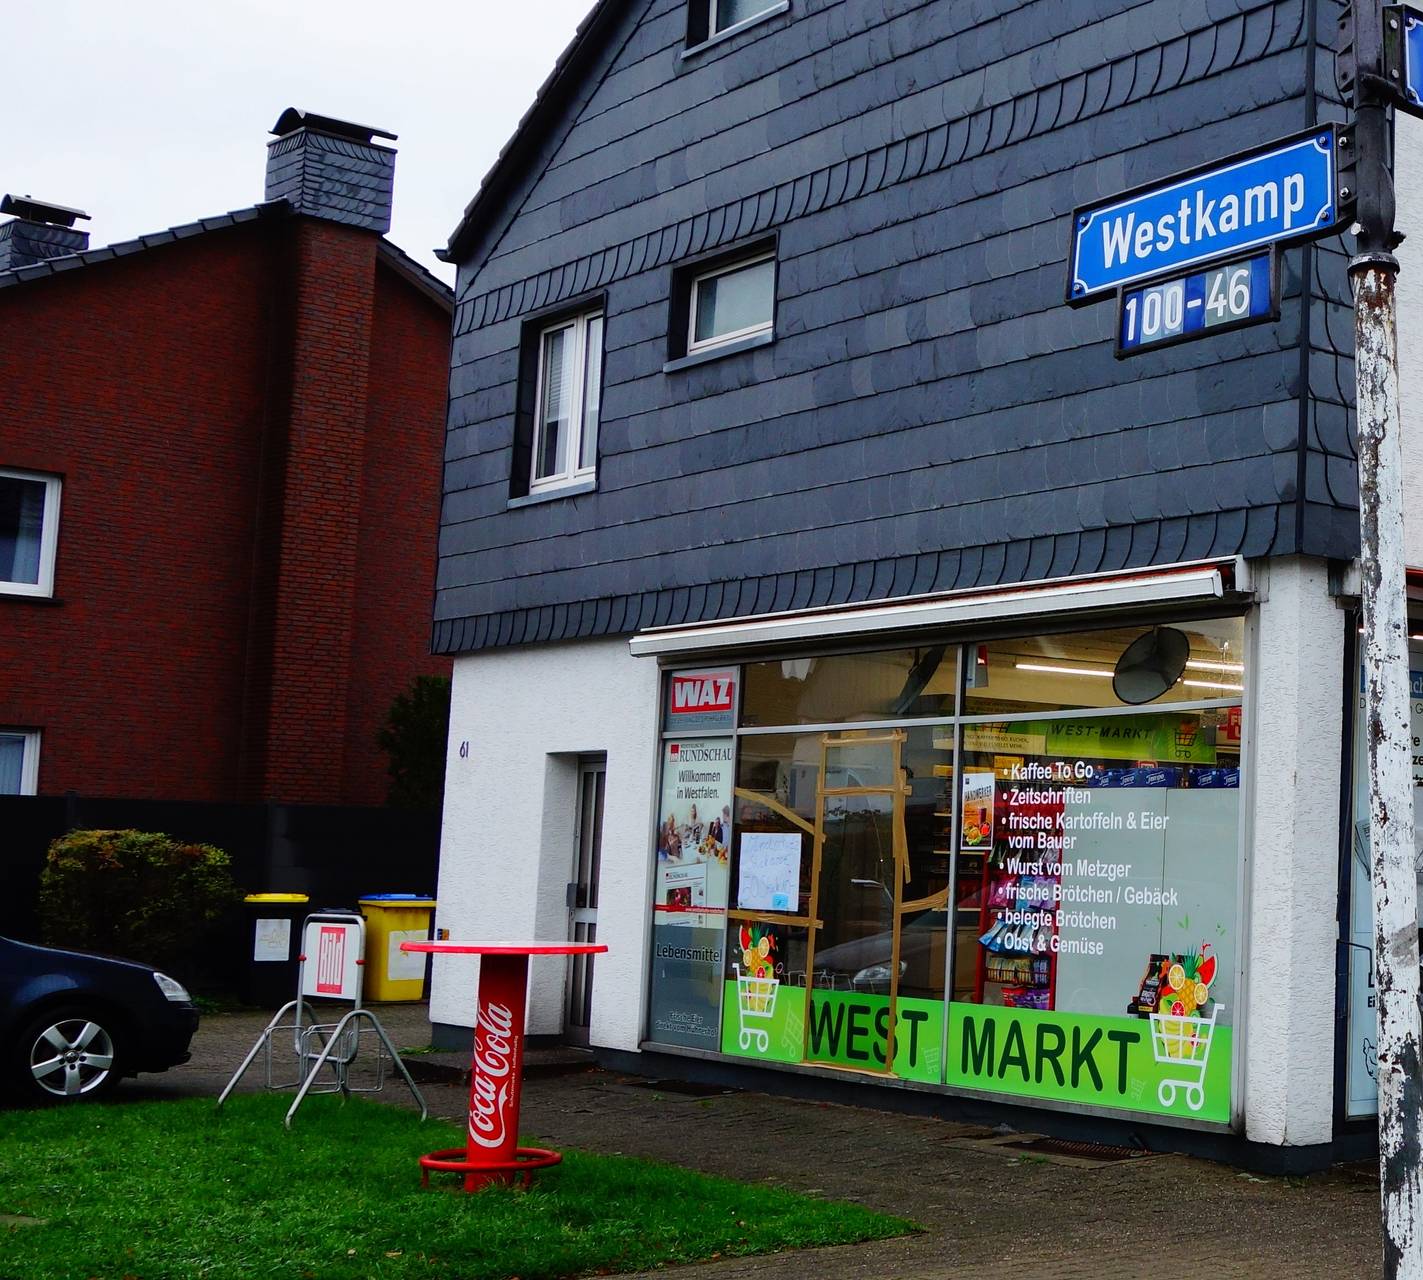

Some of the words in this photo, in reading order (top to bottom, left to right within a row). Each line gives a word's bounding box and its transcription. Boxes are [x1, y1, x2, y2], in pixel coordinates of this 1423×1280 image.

[1102, 172, 1305, 269] Westkamp
[1125, 268, 1250, 341] 100-46
[674, 678, 731, 708] WAZ
[1050, 724, 1150, 741] WEST-MARKT
[459, 741, 470, 759] 61
[679, 748, 733, 762] RUNDSCHAU
[678, 769, 721, 783] Willkommen
[1010, 763, 1052, 780] Kaffee
[1055, 762, 1071, 779] To
[1074, 760, 1094, 779] Go
[676, 786, 683, 800] in
[684, 785, 720, 800] Westfalen.
[1009, 786, 1091, 806] Zeitschriften
[1008, 811, 1053, 830] frische
[1055, 811, 1122, 830] Kartoffeln
[1126, 812, 1137, 830] &
[1140, 811, 1170, 830] Eier
[1008, 836, 1034, 850] vom
[1037, 831, 1077, 850] Bauer
[1006, 857, 1044, 876] Wurst
[1046, 862, 1073, 876] vom
[1076, 859, 1132, 882] Metzger
[1005, 883, 1049, 901] frische
[1053, 883, 1113, 904] Brötchen
[1124, 886, 1179, 906] Gebäck
[1004, 907, 1053, 930] belegte
[1055, 910, 1117, 930] Brötchen
[656, 943, 723, 962] Lebensmittel
[1003, 932, 1034, 951] Obst
[1036, 934, 1047, 952] &
[1050, 935, 1104, 955] Gemüse
[810, 1002, 929, 1068] WEST
[961, 1015, 1142, 1095] MARKT
